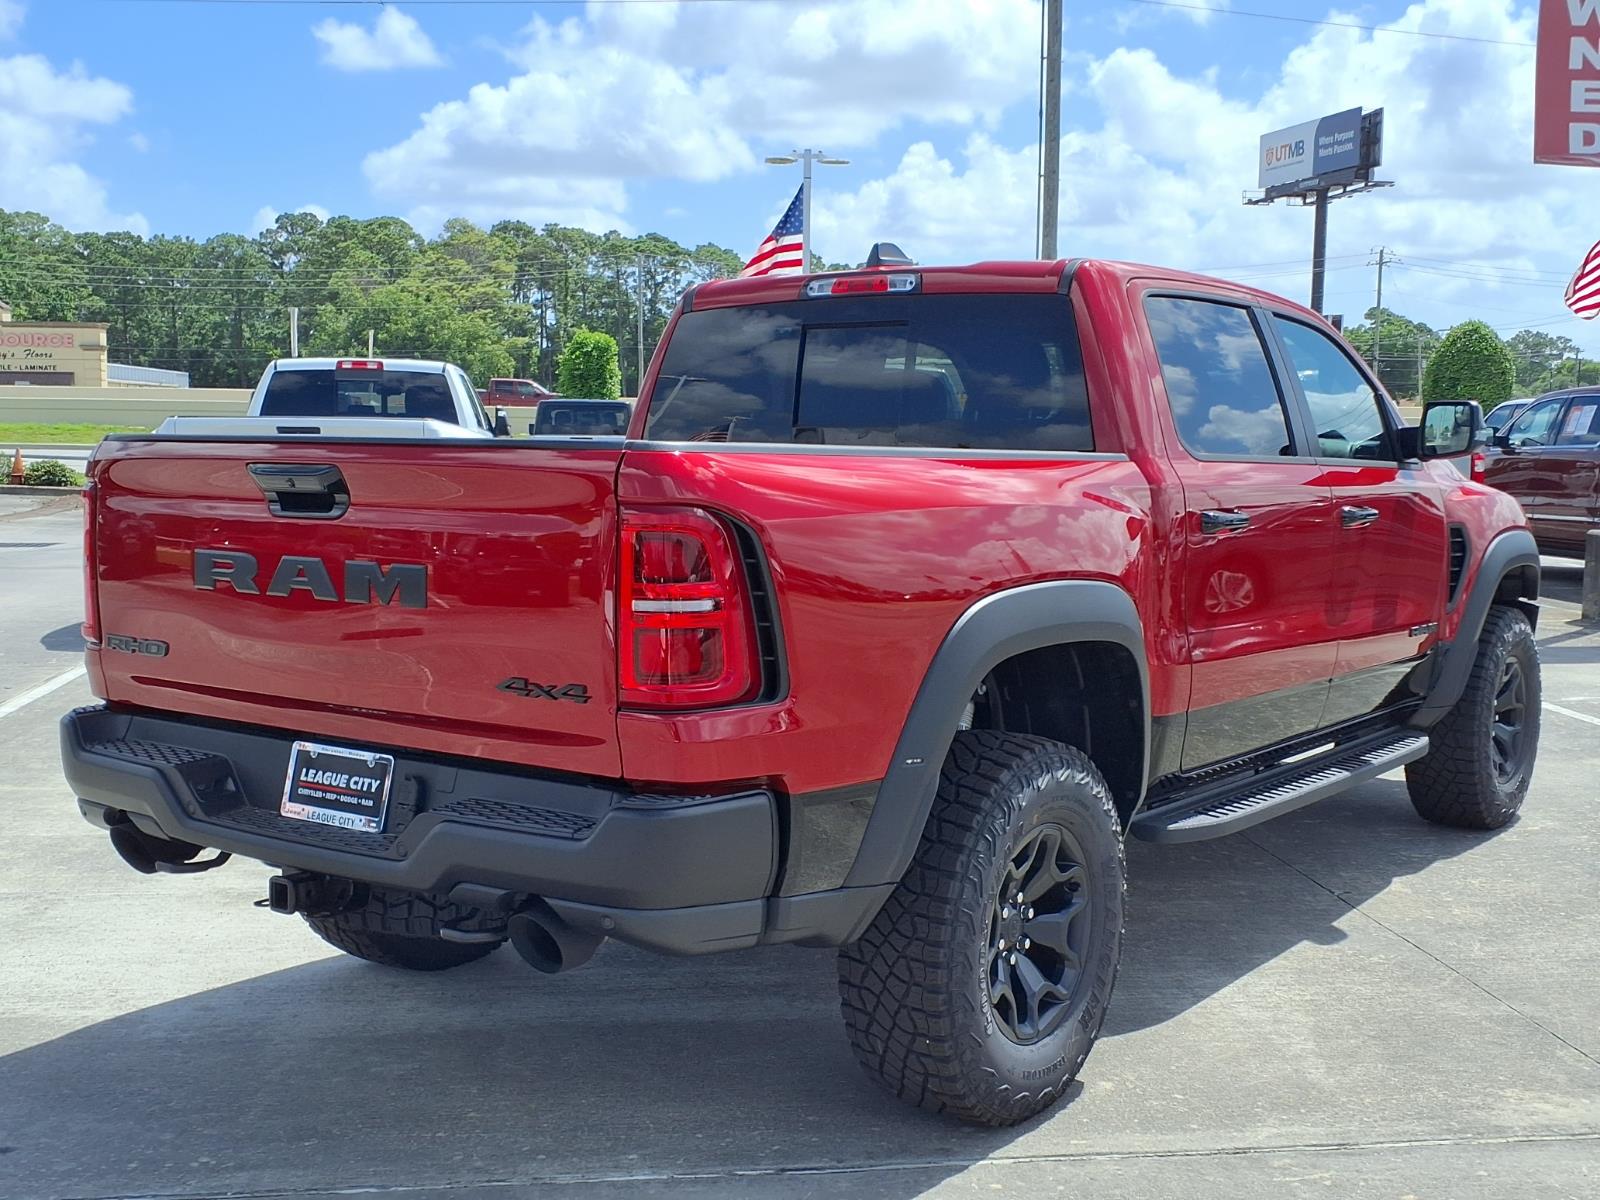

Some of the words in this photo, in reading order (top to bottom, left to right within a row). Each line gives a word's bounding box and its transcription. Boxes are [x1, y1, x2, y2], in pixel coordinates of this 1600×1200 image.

[1275, 139, 1305, 162] UTMB
[24, 348, 53, 360] Floors
[194, 548, 428, 608] RAM
[106, 634, 169, 657] RHO
[300, 767, 349, 789] LEAGUE
[349, 775, 381, 793] CITY
[298, 787, 323, 798] CHRYSLER
[325, 792, 338, 801] JEEP
[340, 795, 358, 805] DODGE
[361, 798, 374, 807] RAM
[306, 809, 338, 825] LEAGUE
[338, 815, 356, 828] CITY
